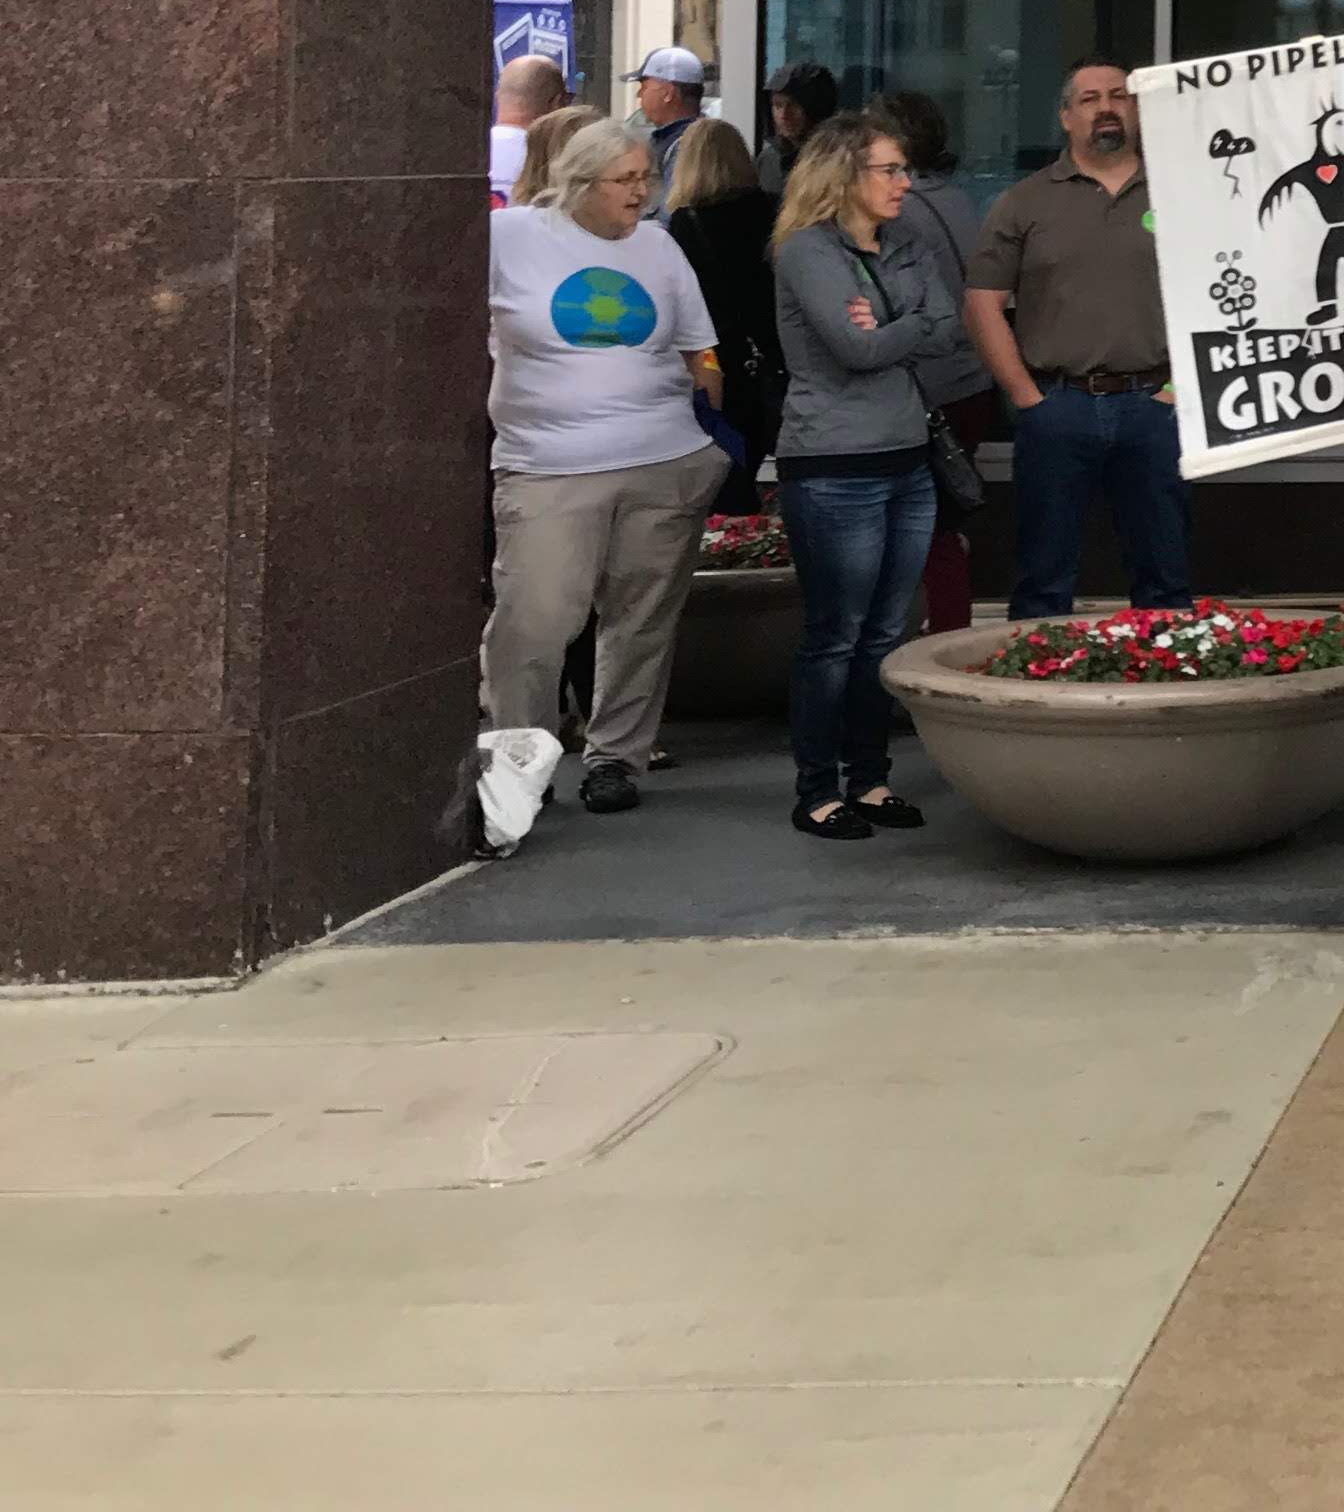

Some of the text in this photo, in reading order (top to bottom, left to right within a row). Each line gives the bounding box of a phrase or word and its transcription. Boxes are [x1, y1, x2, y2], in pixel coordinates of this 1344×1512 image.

[1176, 60, 1232, 95] NO
[1210, 333, 1306, 372] KEEP
[1311, 325, 1344, 356] IT
